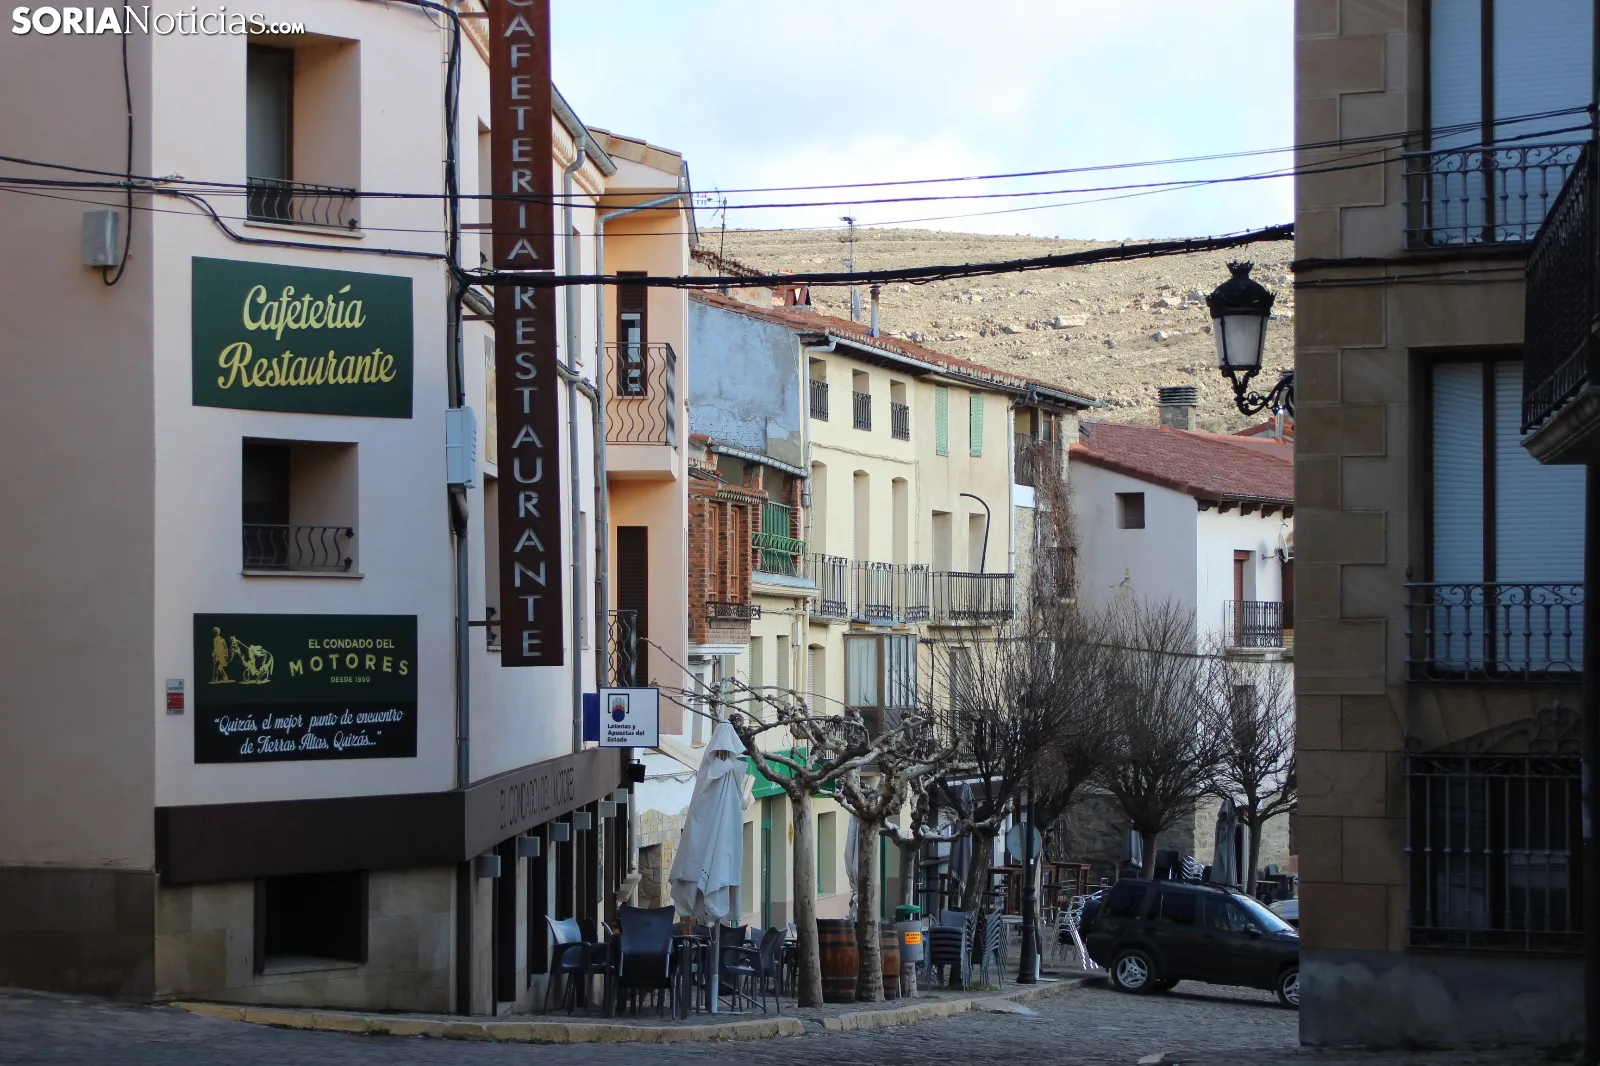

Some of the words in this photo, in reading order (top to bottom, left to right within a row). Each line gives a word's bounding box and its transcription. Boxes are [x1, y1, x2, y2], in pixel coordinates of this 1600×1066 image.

[503, 0, 540, 261] AFETERIA
[243, 284, 366, 341] Cafetería
[217, 341, 397, 389] Restaurante
[510, 283, 547, 657] RESTAURANTE
[308, 639, 321, 649] EL
[323, 638, 374, 649] CONDADO
[376, 638, 395, 649] DEL
[288, 653, 409, 676] MOTORES
[262, 712, 273, 730] el
[274, 714, 304, 734] mejor
[307, 712, 339, 733] punto
[340, 708, 354, 725] de
[356, 708, 405, 724] encuentro
[240, 737, 255, 755] de
[257, 735, 297, 753] Tierras
